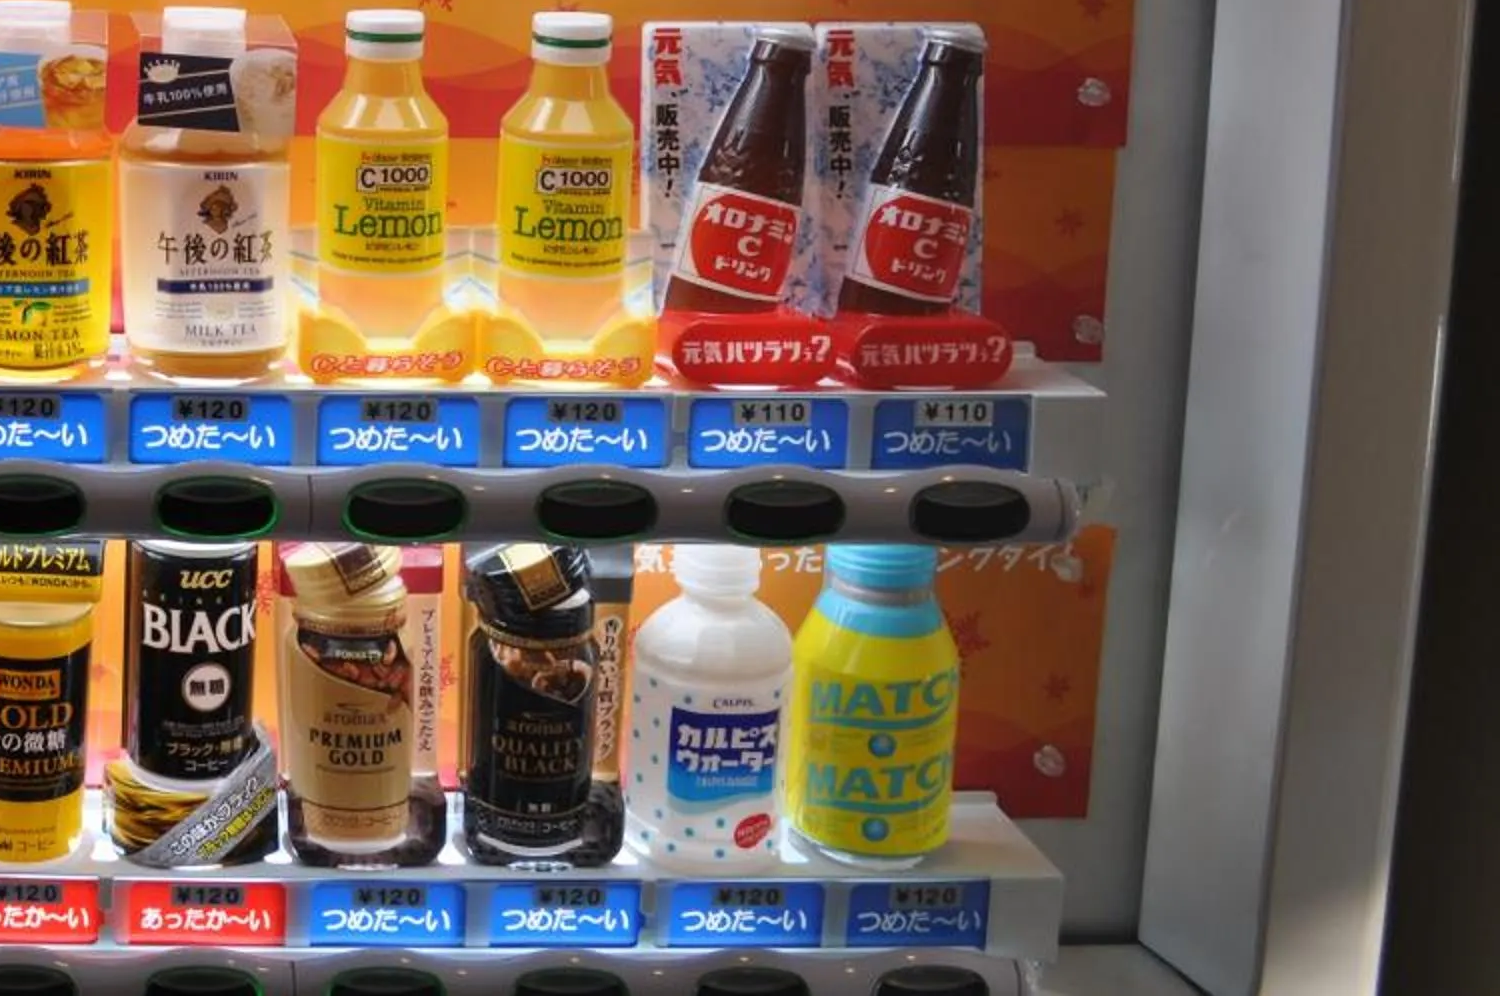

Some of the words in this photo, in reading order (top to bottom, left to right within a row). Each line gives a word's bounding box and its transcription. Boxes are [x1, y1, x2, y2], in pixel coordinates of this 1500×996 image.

[334, 206, 443, 239] Lemon
[513, 207, 623, 242] Lemon
[737, 237, 764, 257] C
[912, 239, 939, 259] C
[714, 256, 772, 282] ドリンク
[891, 260, 948, 285] ドリンク
[50, 327, 80, 341] TEA
[178, 399, 244, 420] ¥120
[364, 402, 431, 421] ¥120
[552, 403, 617, 422] ¥120
[740, 404, 805, 422] ¥110
[924, 404, 987, 422] ¥110
[141, 422, 277, 450] つめた〜い
[329, 425, 463, 451] つめた〜い
[515, 426, 648, 453] つめた〜い
[700, 428, 831, 454] つめた〜い
[883, 429, 1012, 455] つめた〜い
[141, 599, 257, 654] BLACK
[309, 727, 403, 752] PREMIUM
[677, 723, 778, 750] カルピス
[184, 759, 229, 773] コーヒー
[328, 749, 385, 767] GOLD
[503, 754, 577, 776] BLACK
[675, 749, 777, 773] ウォーター
[176, 884, 241, 905] ¥120
[357, 887, 421, 905] ¥120
[538, 887, 601, 905] ¥120
[716, 888, 781, 905] ¥120
[895, 888, 959, 905] ¥120
[140, 904, 271, 931] あったか〜い
[322, 908, 451, 933] つめた〜い
[501, 908, 629, 933] つめた〜い
[679, 909, 808, 933] つめた〜い
[856, 909, 983, 933] つめた〜い
